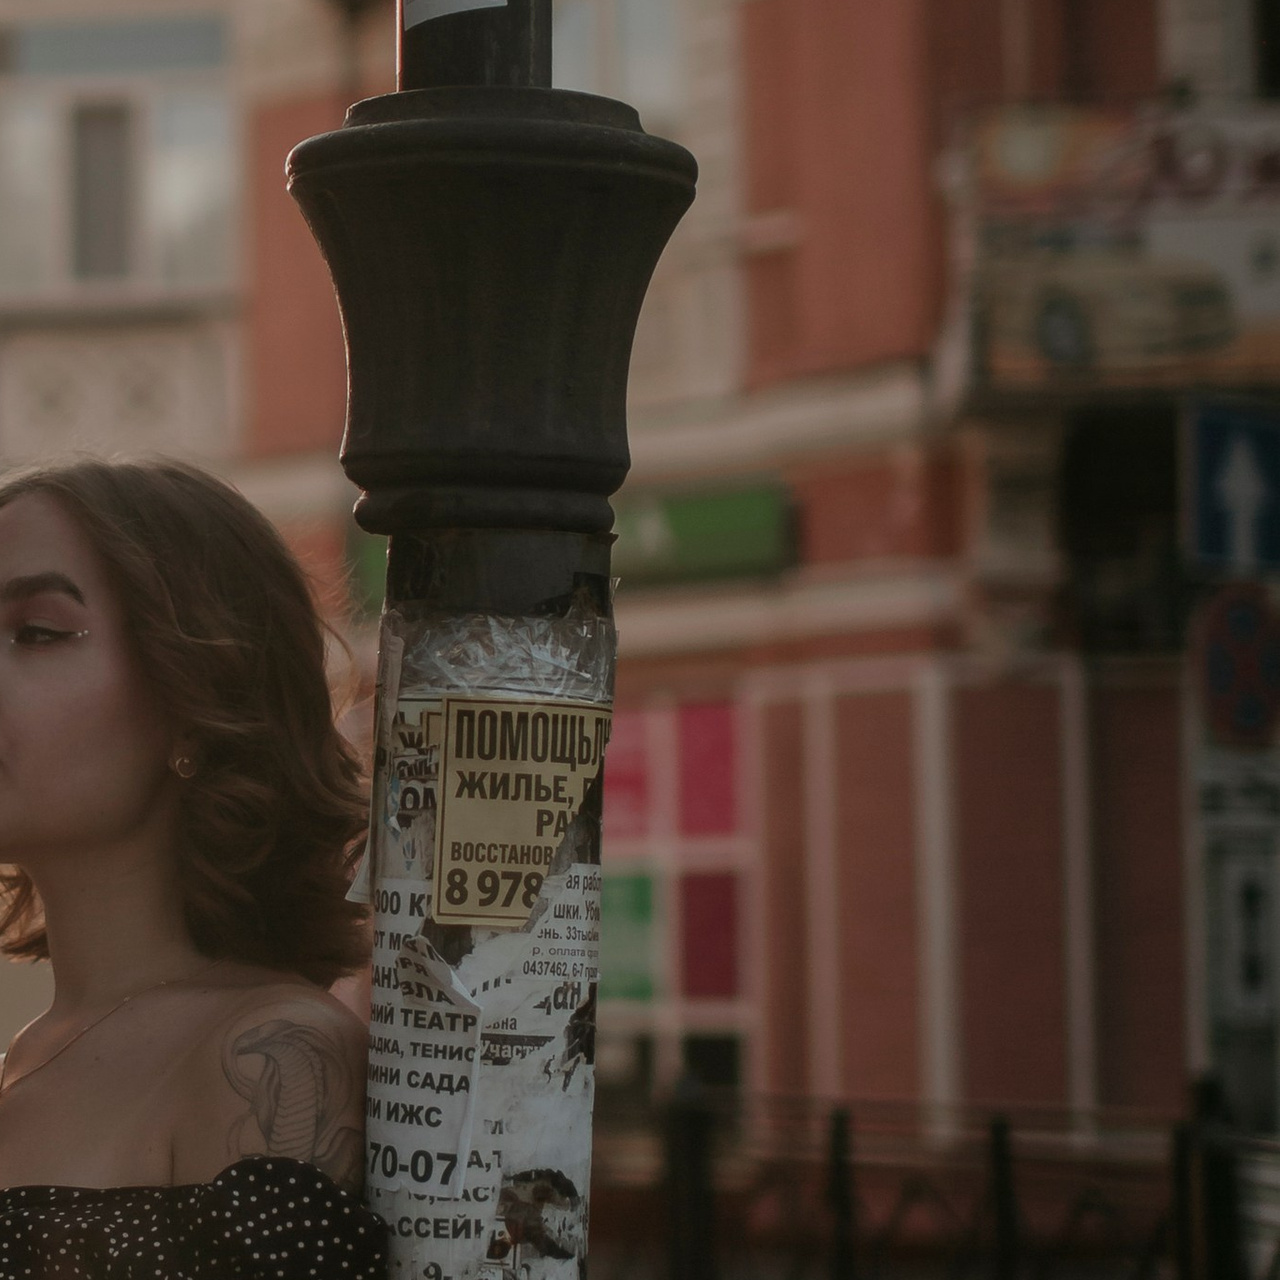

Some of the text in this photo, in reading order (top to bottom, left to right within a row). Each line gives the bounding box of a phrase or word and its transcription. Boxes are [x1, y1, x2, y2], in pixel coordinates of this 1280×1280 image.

[455, 709, 592, 772] ПОМОЩЬ
[455, 770, 574, 809] ЖИЛЬЕ,
[536, 809, 577, 838] РА
[445, 868, 544, 909] 8 978
[400, 1008, 477, 1033] ТЕАТР
[407, 1070, 470, 1095] САДА
[386, 1101, 442, 1127] ИЖС
